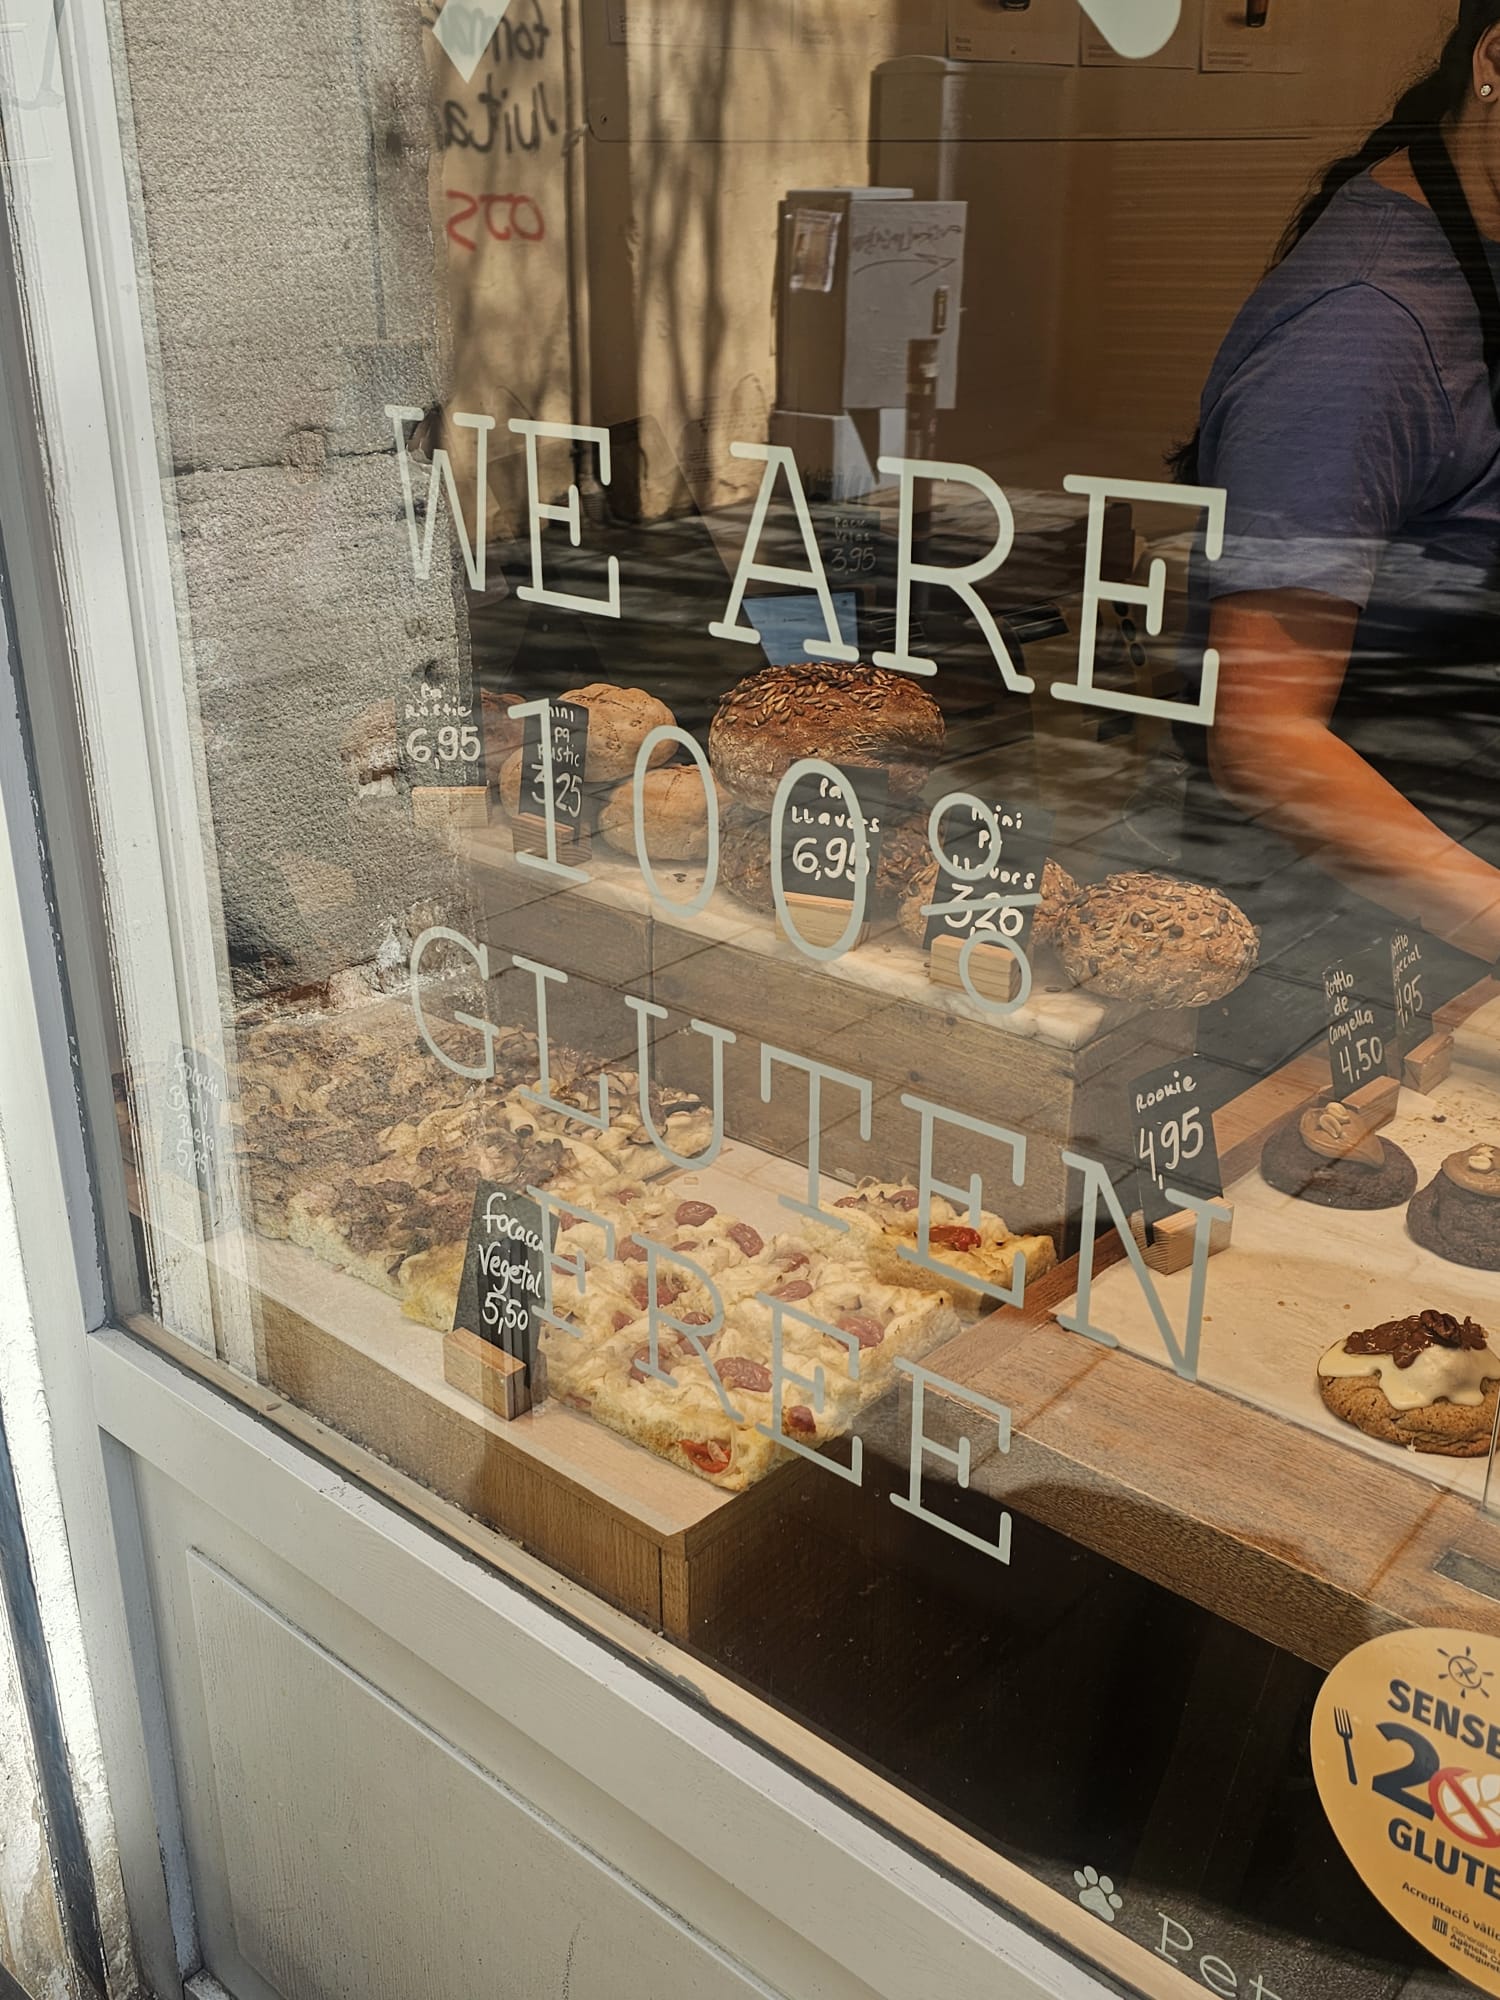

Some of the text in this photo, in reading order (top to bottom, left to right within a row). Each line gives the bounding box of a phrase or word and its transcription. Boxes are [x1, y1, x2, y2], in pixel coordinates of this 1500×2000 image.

[385, 404, 1227, 727] WE ARE
[831, 546, 877, 576] 3,95
[405, 725, 482, 770] 6,95
[531, 763, 583, 819] 325
[819, 777, 843, 800] Pa
[508, 698, 1042, 1014] 100%
[792, 836, 872, 883] 6,95
[1333, 995, 1350, 1017] de
[1338, 1035, 1384, 1084] 4,50
[409, 926, 1234, 1381] GLUTEN
[1138, 1105, 1205, 1191] 4,95
[478, 1240, 542, 1299] Vegetal
[481, 1291, 530, 1335] 5,50
[525, 1183, 1013, 1566] FREE
[1387, 1679, 1500, 1763] SENSE
[1402, 1881, 1470, 1925] Acreditació
[1154, 1911, 1283, 2000] Pet
